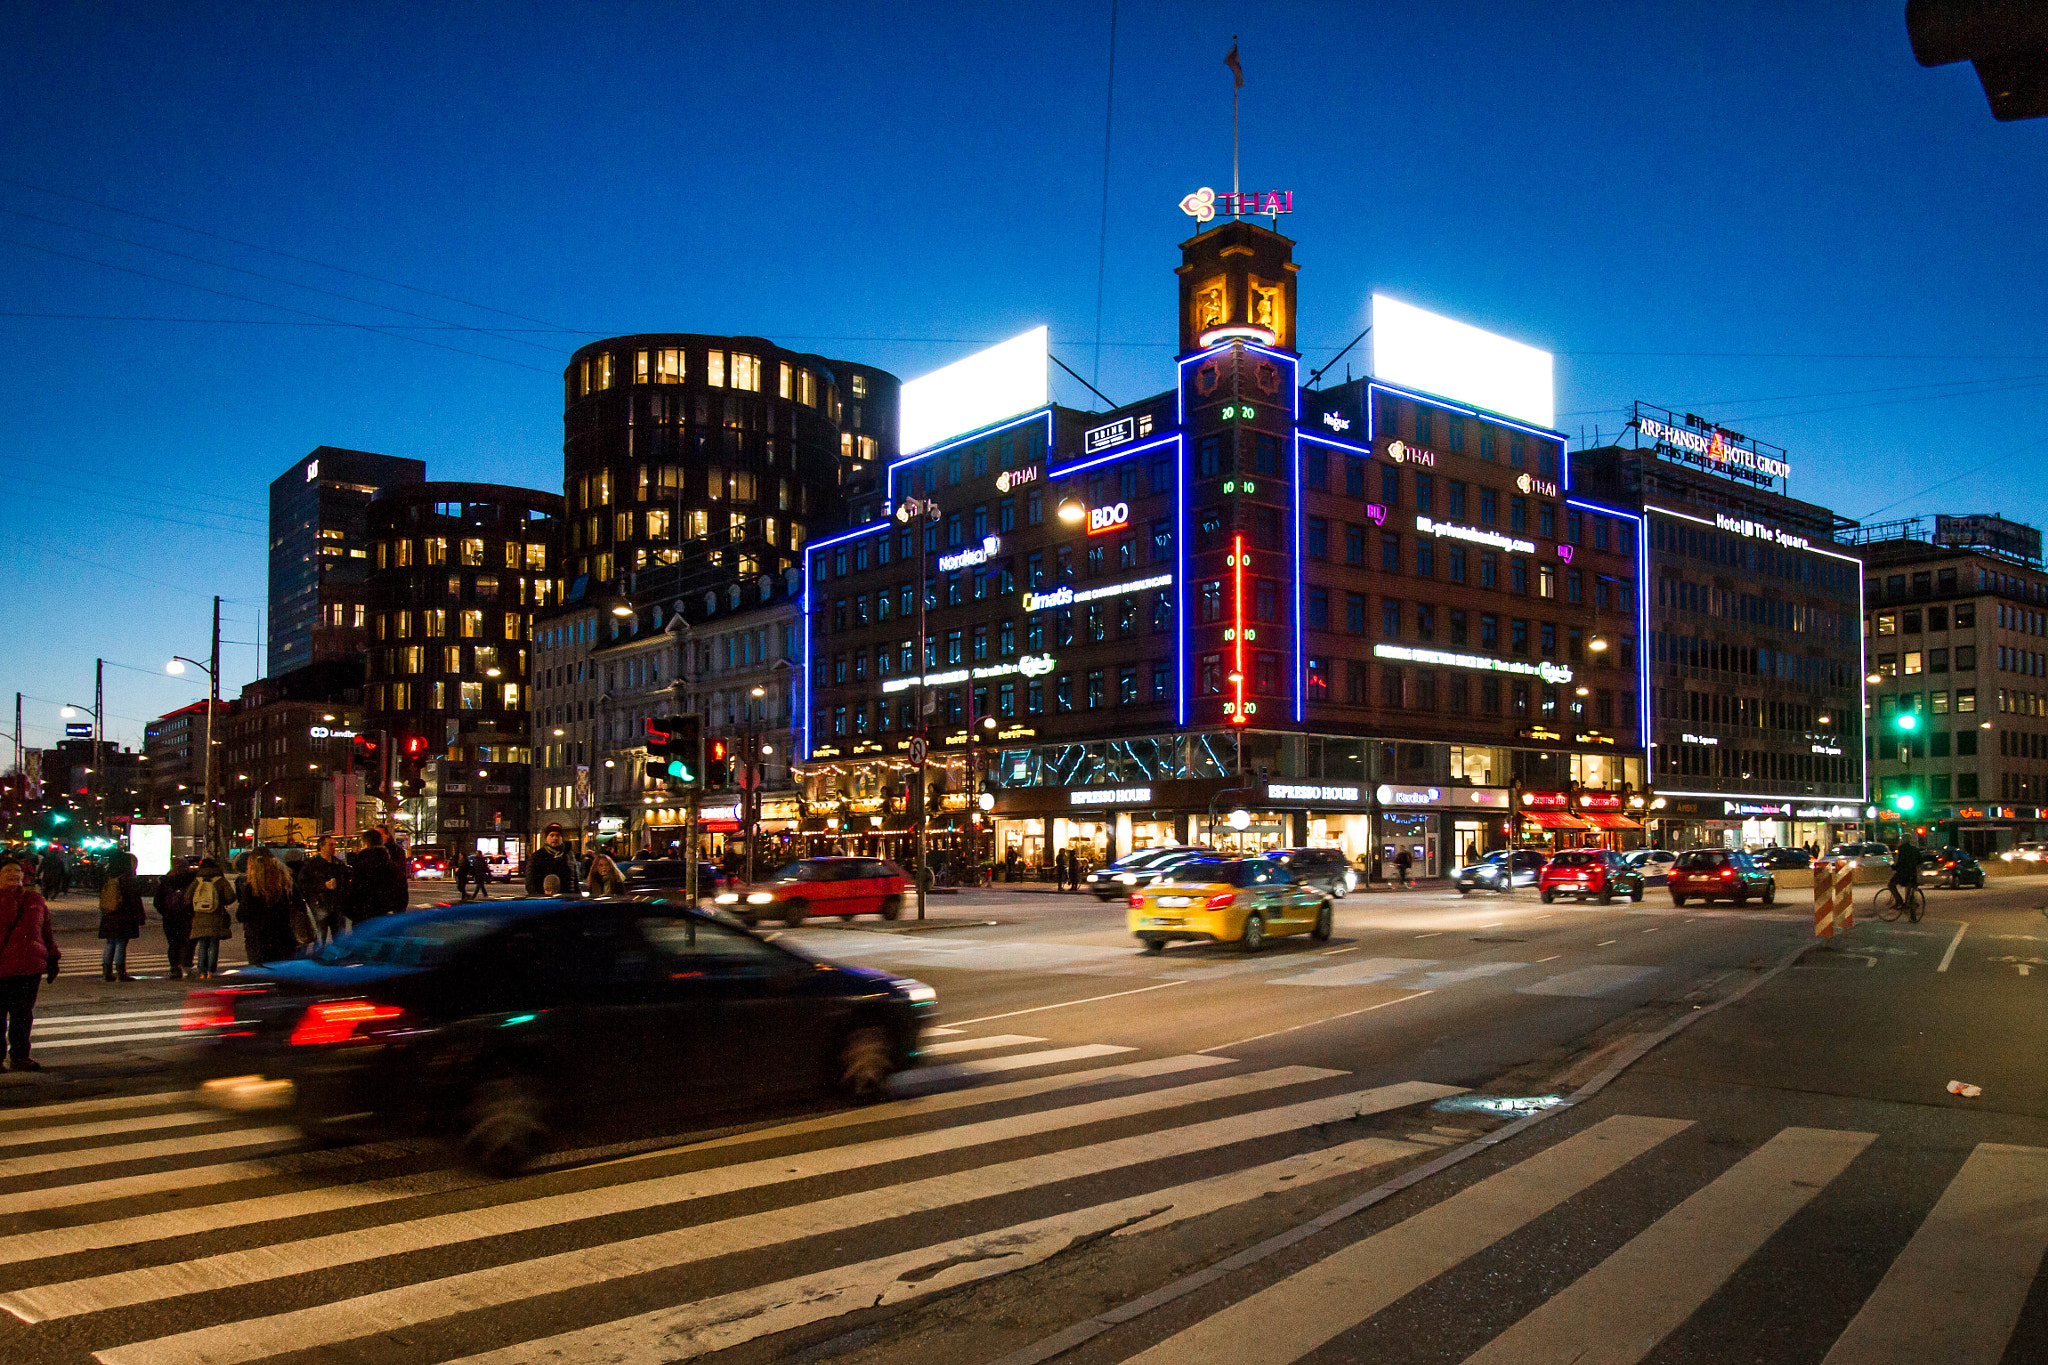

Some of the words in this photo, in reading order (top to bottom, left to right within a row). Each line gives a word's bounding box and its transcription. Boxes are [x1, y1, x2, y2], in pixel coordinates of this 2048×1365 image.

[1217, 190, 1293, 215] THAI
[1222, 406, 1234, 420] 20
[1241, 405, 1255, 419] 20
[1323, 412, 1350, 431] Regus
[1094, 423, 1124, 441] BRINK
[1404, 445, 1436, 467] THAI
[1639, 418, 1709, 454] ARP-HANSEN
[1723, 444, 1757, 469] HOTEL
[1757, 455, 1791, 479] GROUP
[1010, 465, 1037, 487] THAI
[1223, 481, 1234, 494] 10
[1243, 481, 1255, 494] 10
[1530, 477, 1557, 497] THAI
[1091, 502, 1129, 530] BDO
[1716, 512, 1745, 534] Hotel
[1753, 523, 1773, 541] The
[1775, 528, 1809, 549] Square
[938, 549, 987, 572] Nordea
[1226, 554, 1234, 567] 0
[1242, 554, 1251, 567] 0
[1224, 628, 1235, 641] 10
[1244, 628, 1256, 641] 10
[1223, 702, 1235, 714] 20
[1243, 702, 1256, 714] 20
[1070, 789, 1116, 804] ESPRESSO
[1116, 788, 1151, 802] HOUSE
[1268, 784, 1321, 800] ESPRESSO
[1322, 786, 1359, 801] HOUSE
[1395, 792, 1430, 804] Nordea
